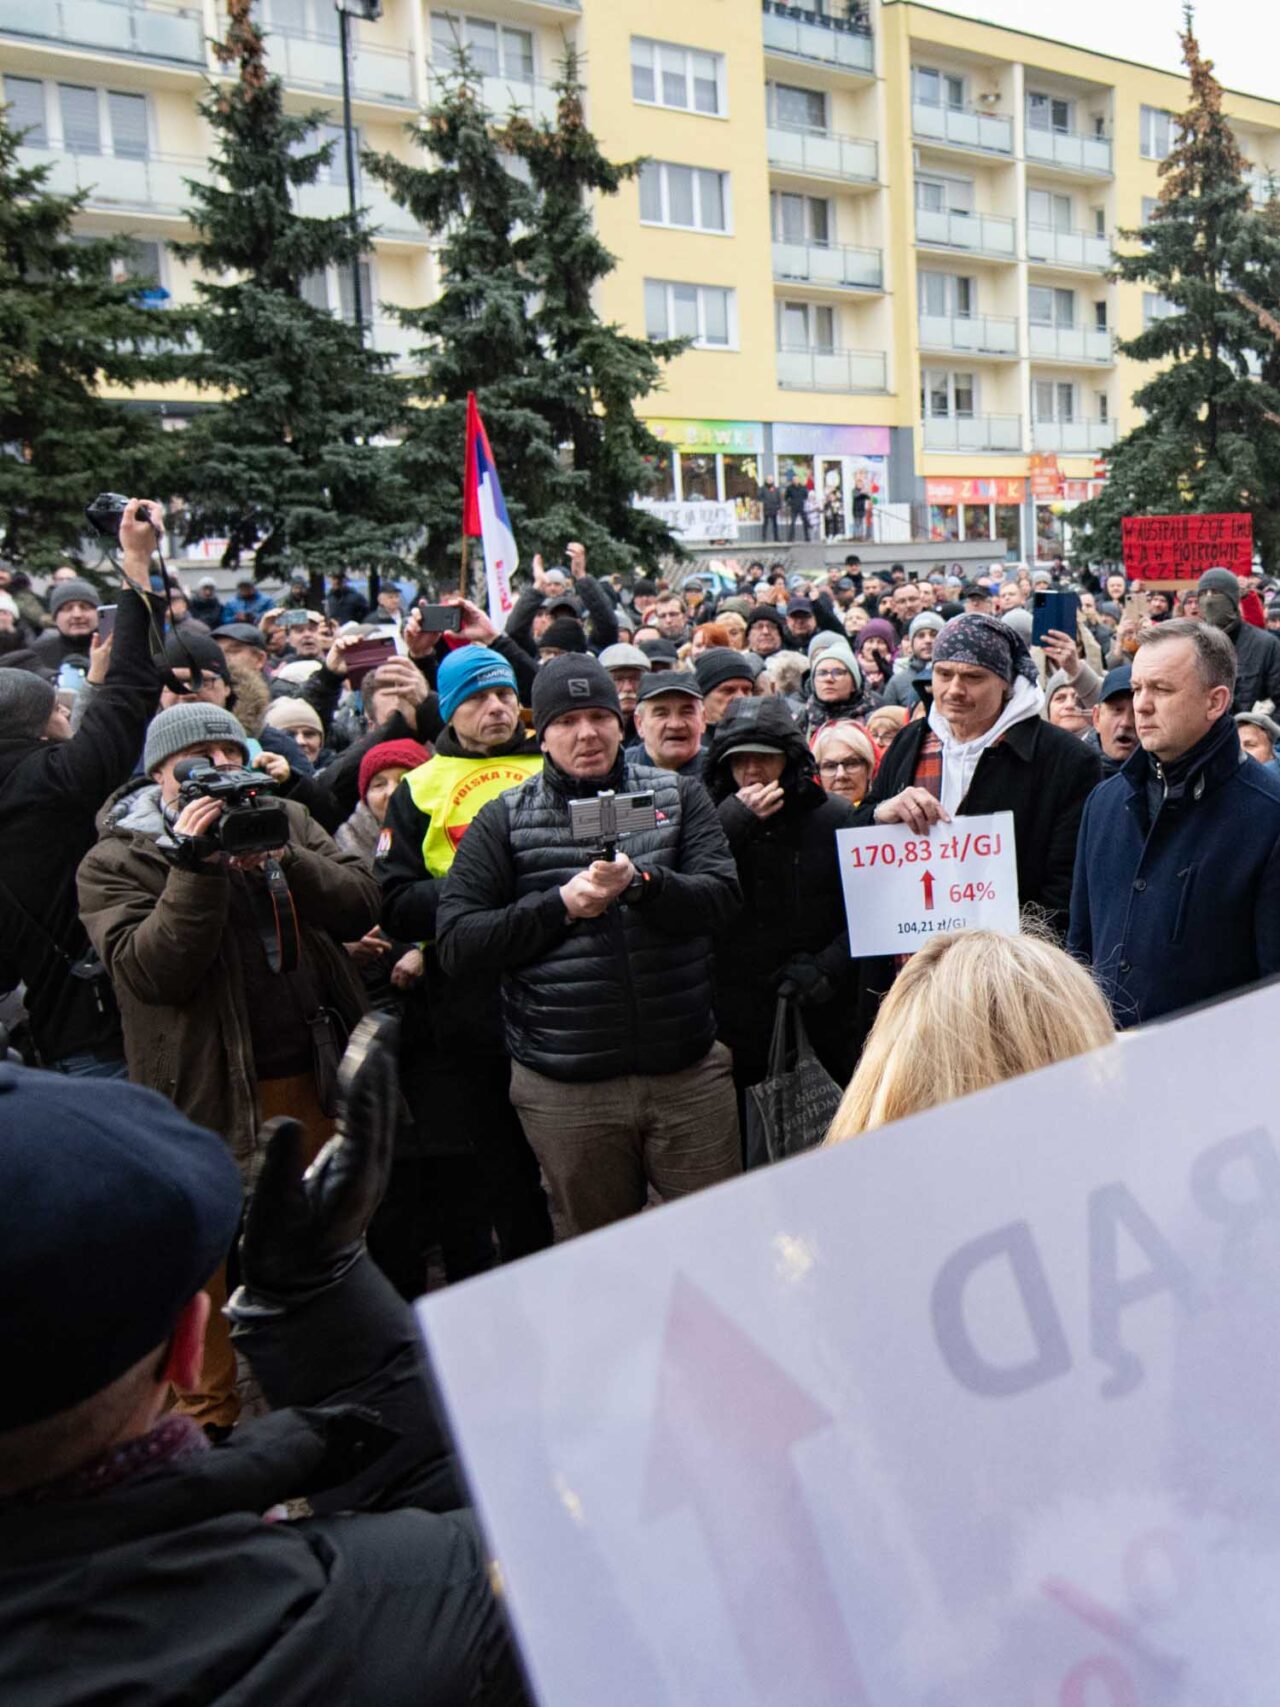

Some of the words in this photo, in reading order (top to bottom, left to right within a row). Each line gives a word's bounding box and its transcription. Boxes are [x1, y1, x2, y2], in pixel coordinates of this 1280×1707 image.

[453, 771, 500, 806] POLSKA
[505, 771, 523, 781] TO
[851, 840, 932, 867] 170,83
[940, 833, 1002, 862] zł/GJ
[949, 881, 995, 903] 64%
[898, 920, 934, 935] 104,21
